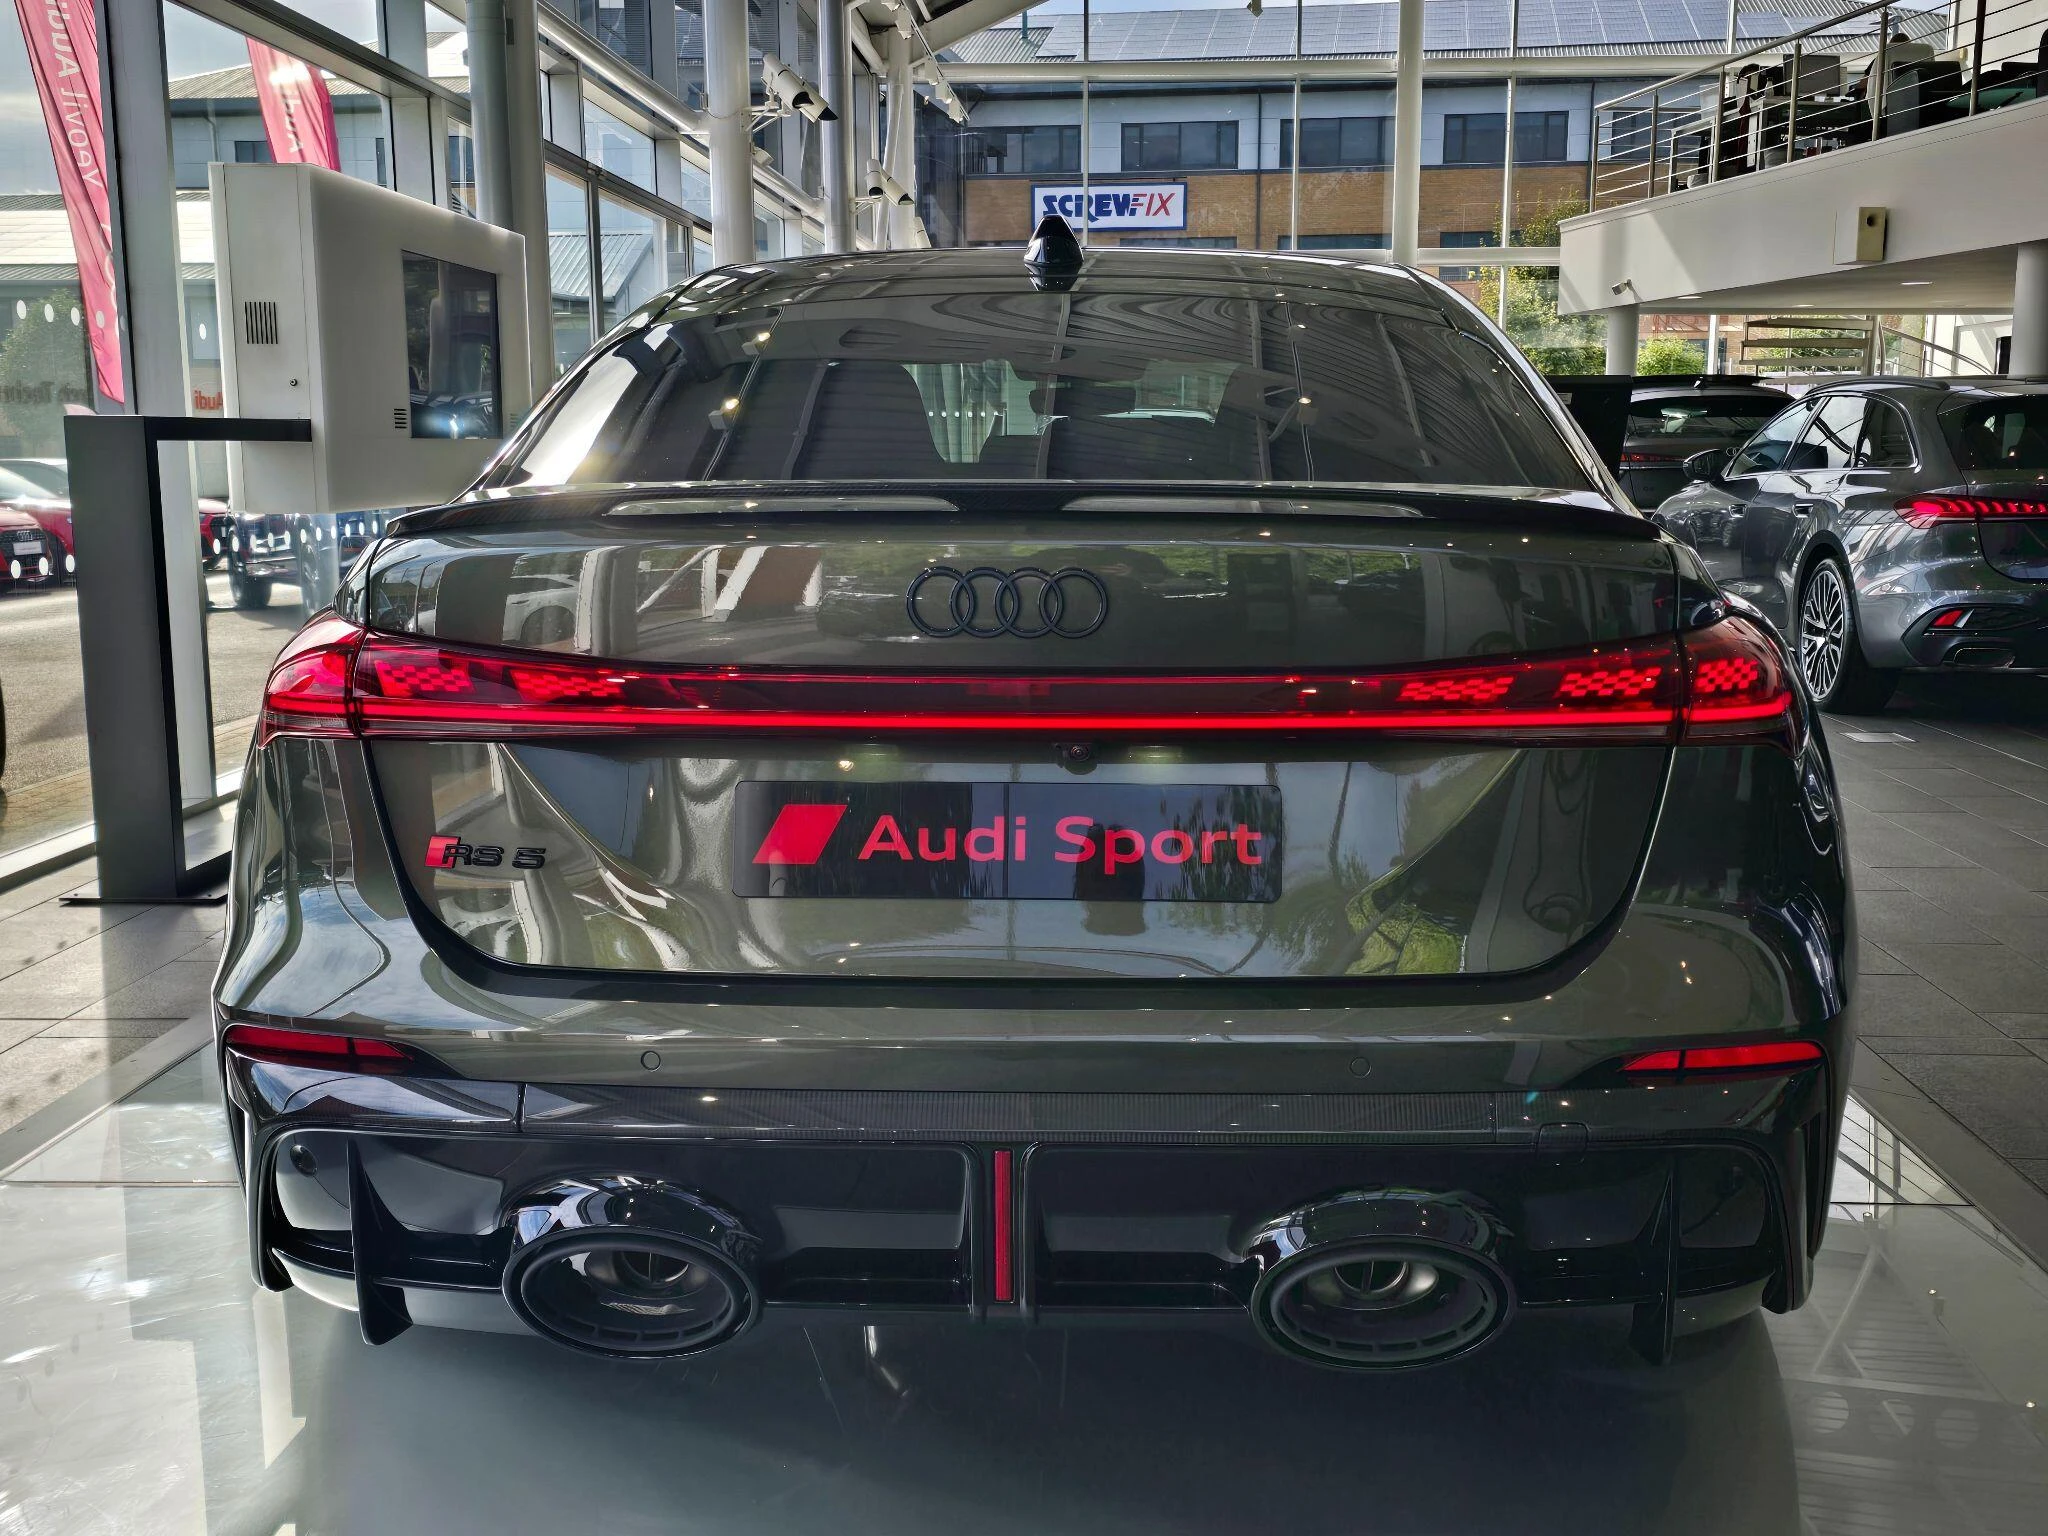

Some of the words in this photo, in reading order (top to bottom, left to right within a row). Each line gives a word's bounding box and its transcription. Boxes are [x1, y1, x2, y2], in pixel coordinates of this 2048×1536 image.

[1042, 192, 1176, 223] SCREWFIX
[442, 843, 505, 867] RS
[511, 847, 547, 869] 5
[857, 814, 1026, 862] Audi
[1054, 815, 1262, 875] Sport
